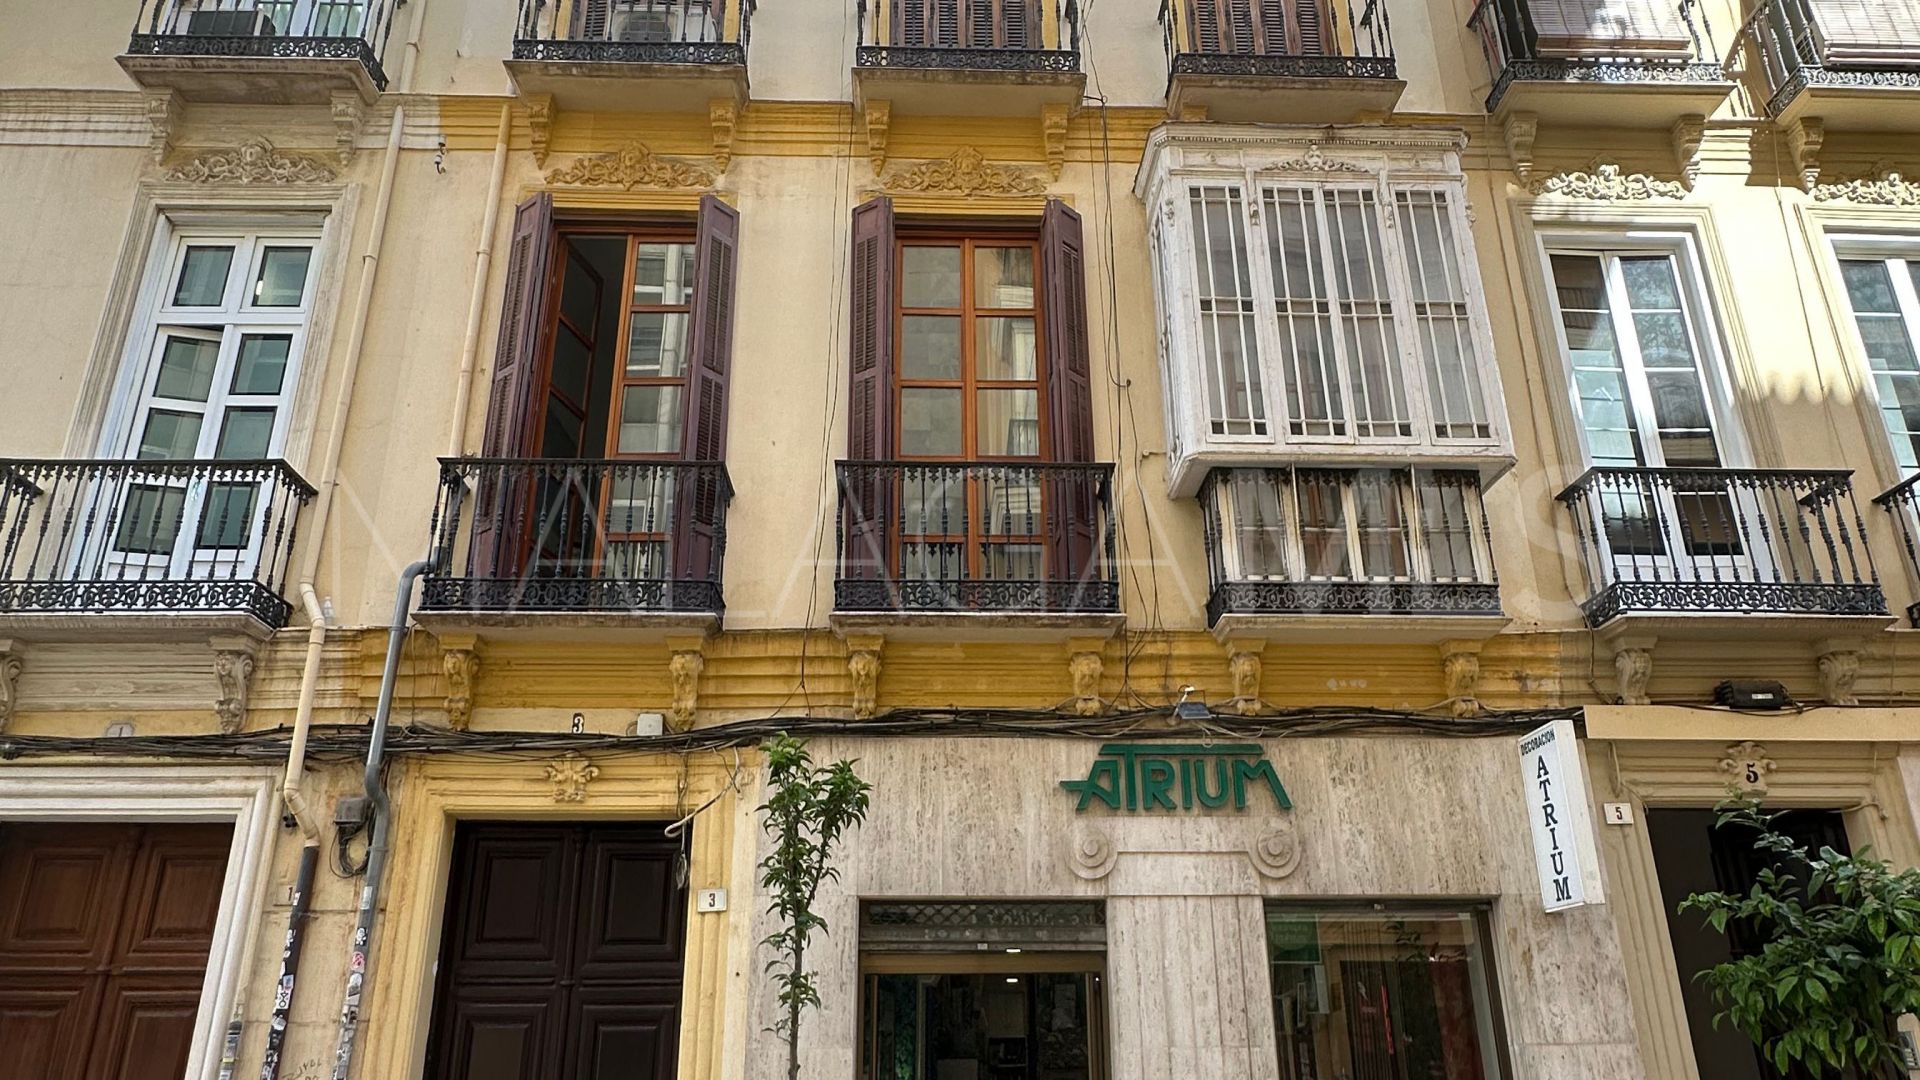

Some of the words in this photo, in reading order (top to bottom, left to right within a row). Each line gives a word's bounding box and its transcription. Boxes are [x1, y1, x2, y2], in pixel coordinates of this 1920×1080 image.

[573, 716, 584, 734] 3
[1520, 727, 1556, 756] DECORACION
[1059, 743, 1293, 812] ATRIUM
[1746, 762, 1759, 784] 5
[1615, 806, 1623, 820] 5
[1536, 755, 1572, 902] ATRIUM
[709, 892, 716, 908] 3
